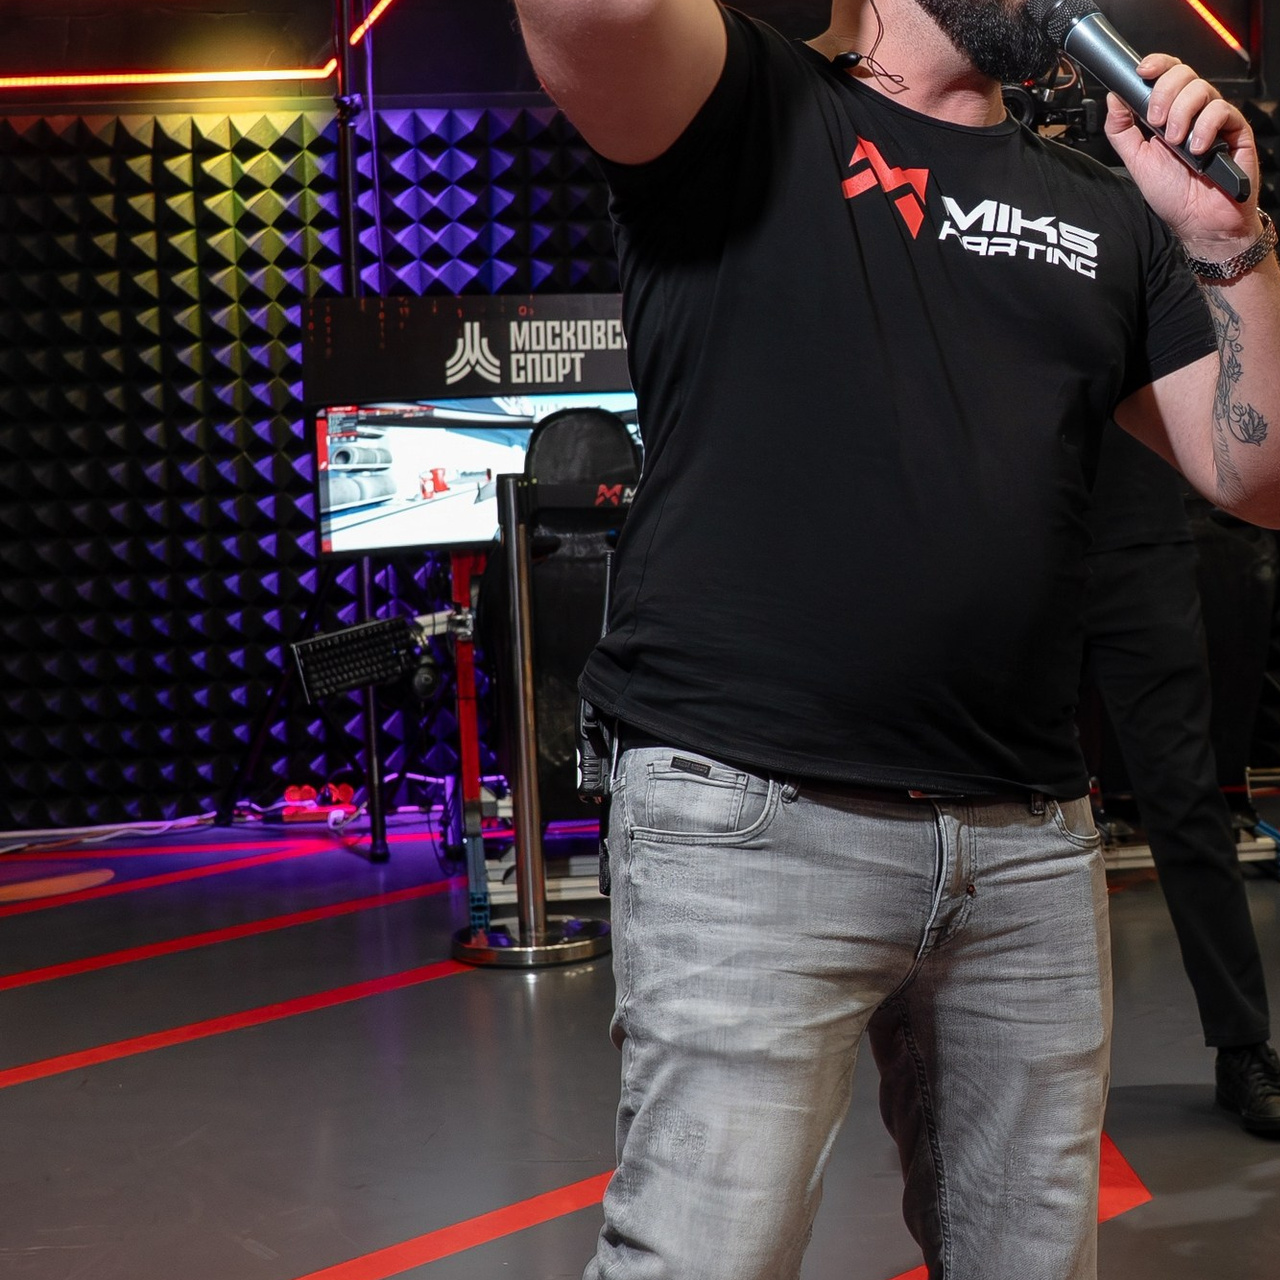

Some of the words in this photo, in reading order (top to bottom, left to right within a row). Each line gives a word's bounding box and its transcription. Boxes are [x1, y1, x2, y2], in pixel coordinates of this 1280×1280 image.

[938, 221, 1098, 279] KARTING
[941, 196, 1100, 258] MIKS
[510, 352, 585, 384] СПОРТ
